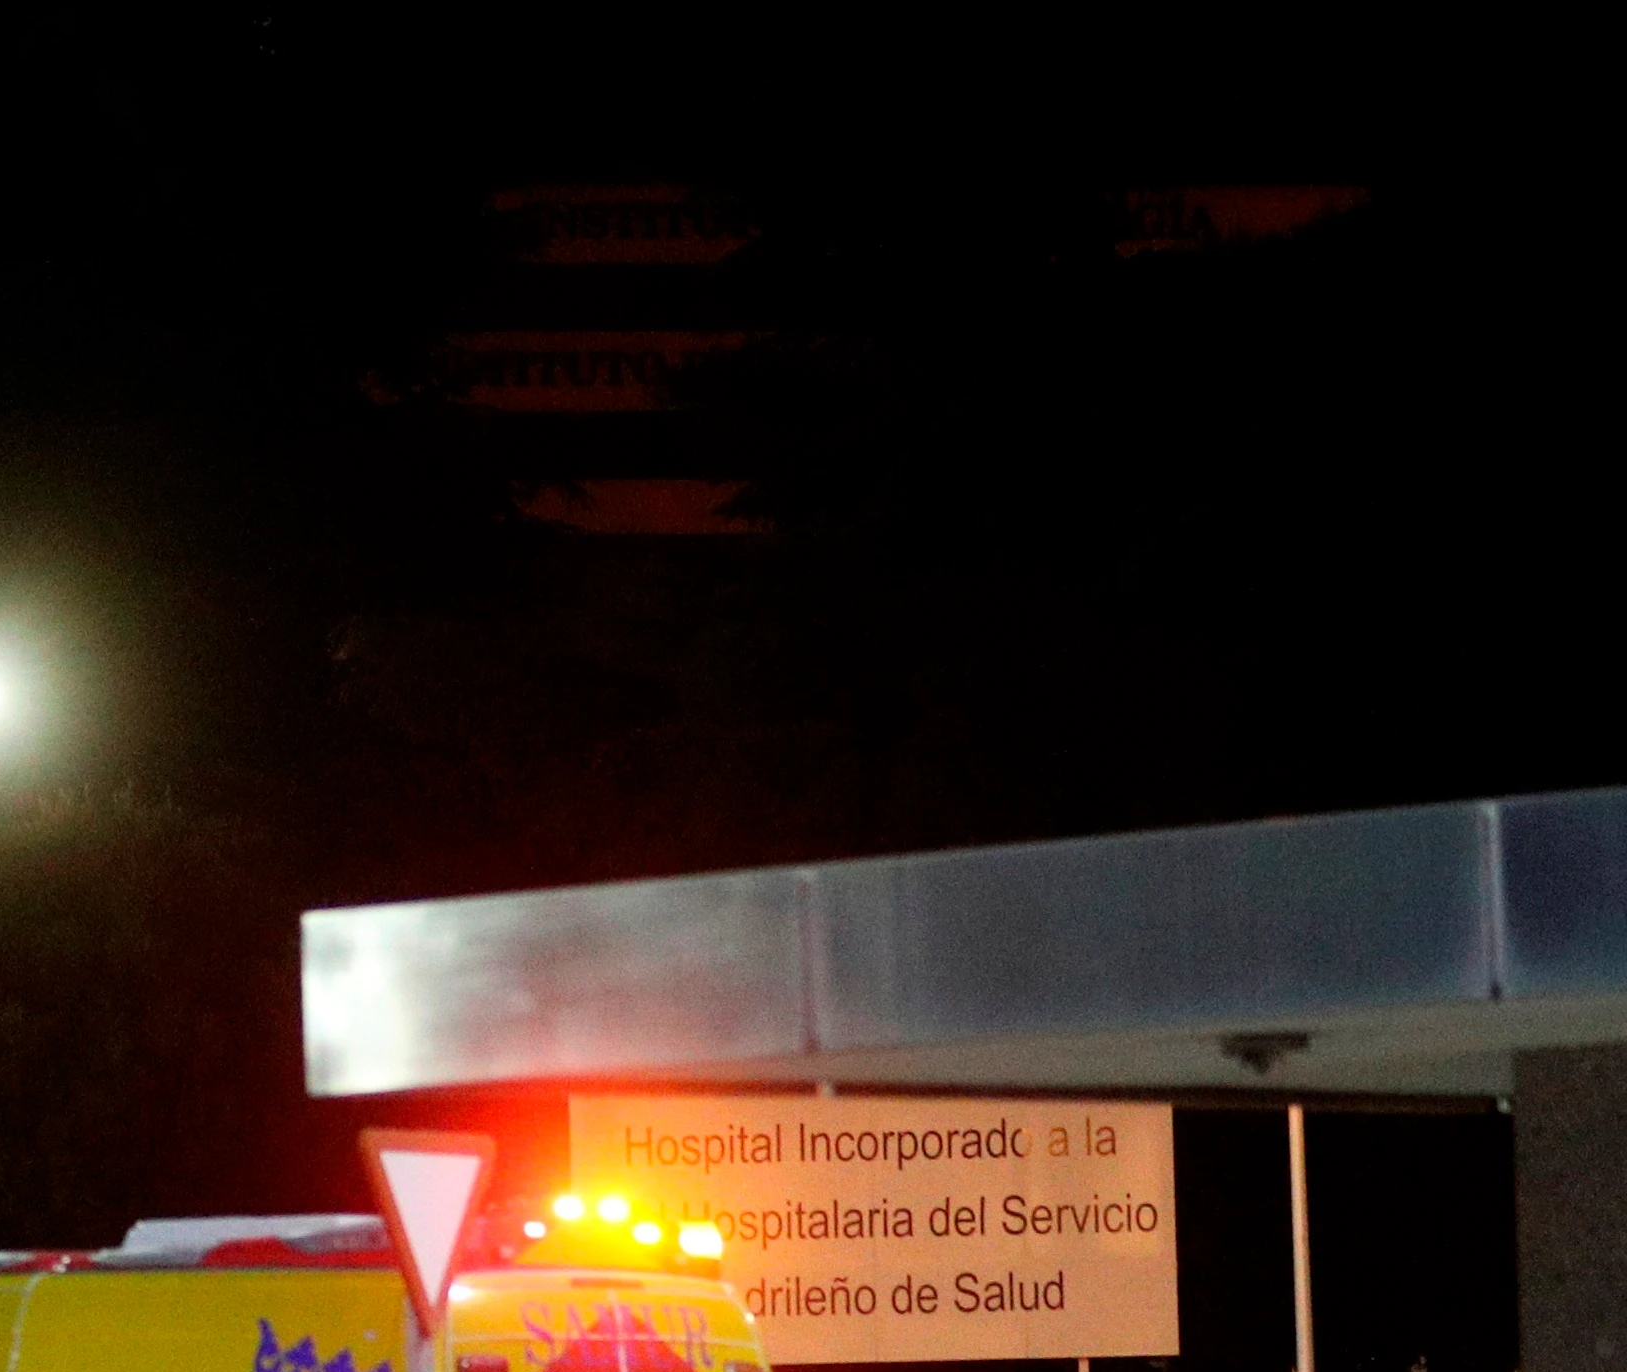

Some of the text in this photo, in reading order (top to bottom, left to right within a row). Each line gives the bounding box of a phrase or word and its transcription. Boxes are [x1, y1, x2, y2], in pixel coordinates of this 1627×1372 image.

[623, 1116, 1117, 1174] Hospital Incorporado a la
[929, 1196, 986, 1240] del
[1001, 1193, 1159, 1236] Servicio
[745, 1270, 1066, 1319] drileño de Salud
